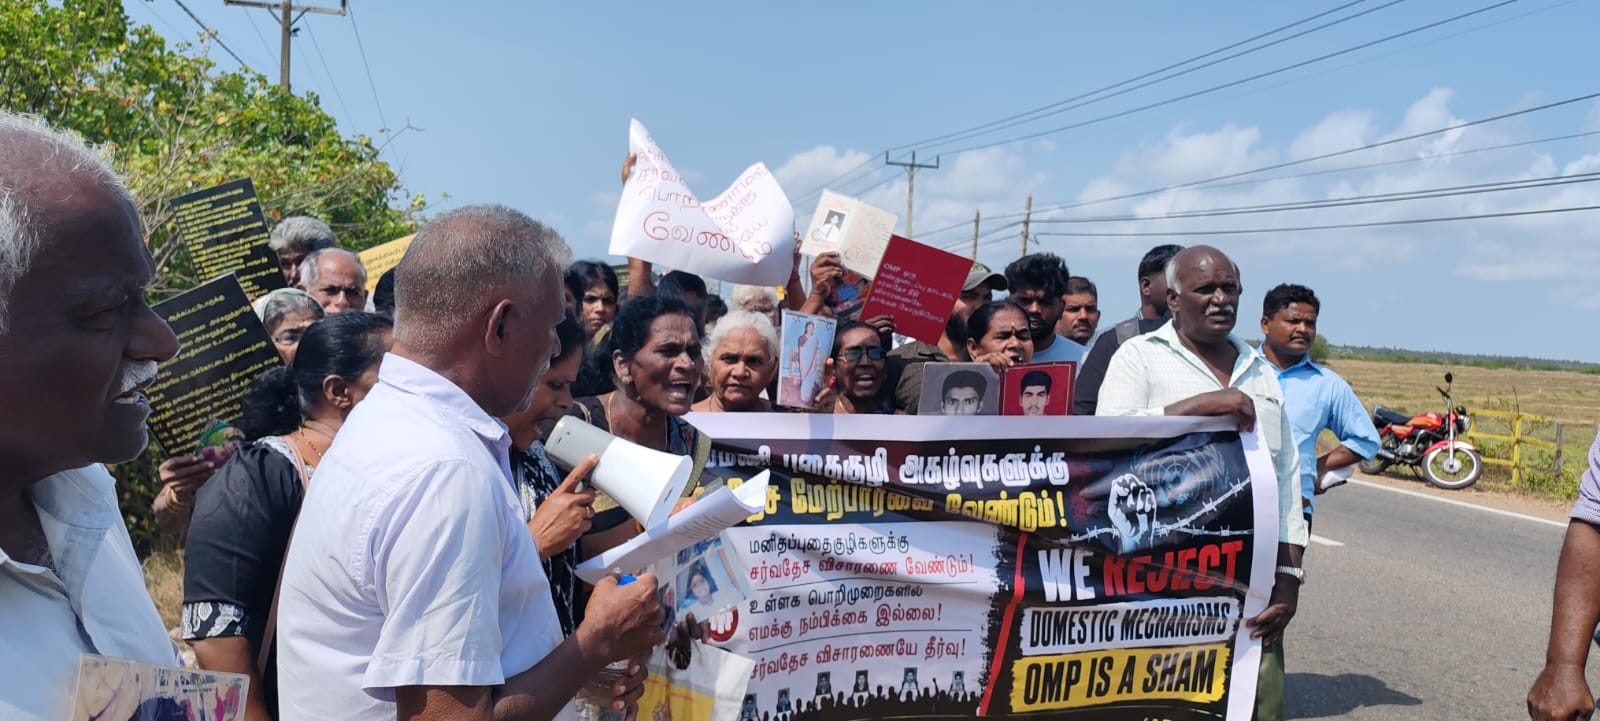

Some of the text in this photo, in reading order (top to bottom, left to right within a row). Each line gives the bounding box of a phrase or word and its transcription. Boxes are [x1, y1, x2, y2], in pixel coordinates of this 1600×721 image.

[877, 280, 907, 293] சர்வதேச
[883, 262, 917, 280] OMP ஒரு
[870, 296, 897, 308] நாங்கள்
[898, 445, 1071, 490] அகழ்வுகளுக்கு
[790, 477, 935, 522] மேற்பார்வை
[944, 489, 1069, 532] வேண்டும்!
[749, 531, 910, 557] மனிதப்புதைகுழிகளுக்கு
[749, 554, 975, 582] சர்வதேச விசாரணை வேண்டும்!
[1037, 540, 1244, 602] WE REJECT
[749, 583, 924, 615] உள்ளக பொறிமுறைகளில்
[748, 603, 943, 642] எமக்கு நம்பிக்கை இல்லை!
[1029, 602, 1231, 648] DOMESTIC MECHANISMS
[749, 637, 967, 681] சர்வதேச விசாரணையே தீர்வு!
[1023, 649, 1218, 705] OMP IS A SHAM
